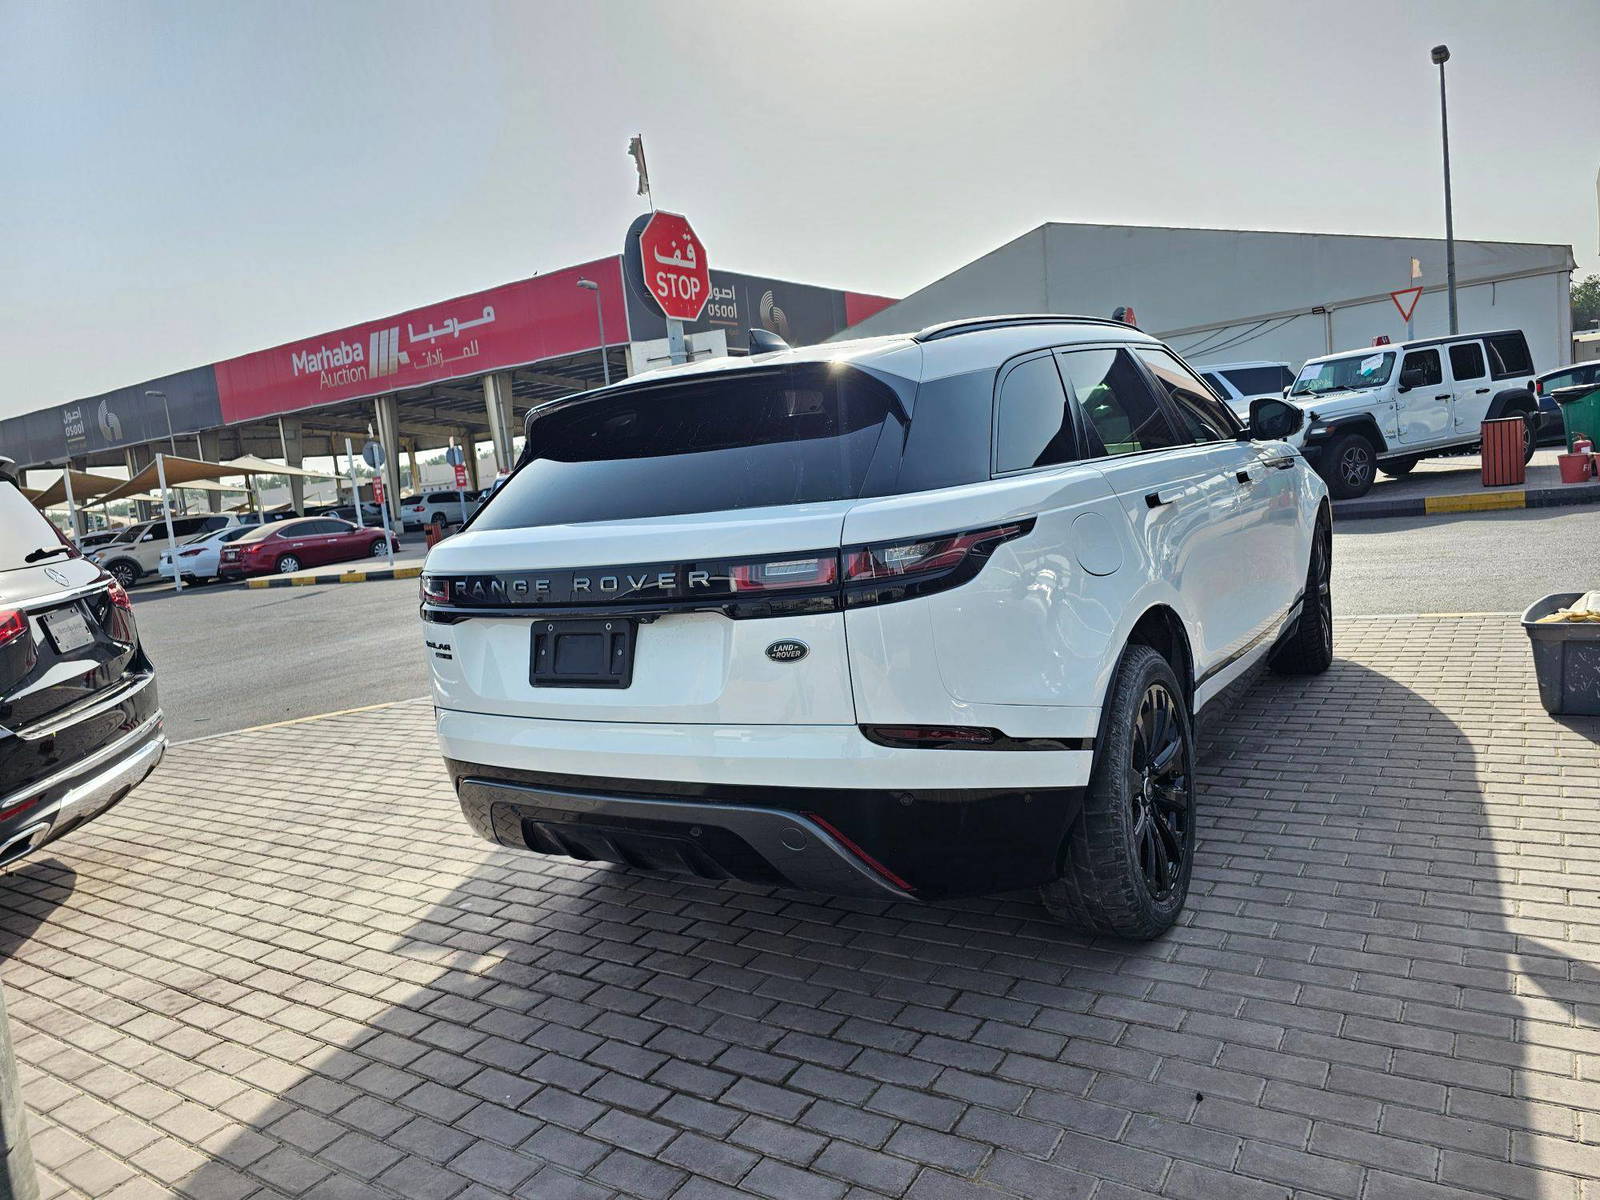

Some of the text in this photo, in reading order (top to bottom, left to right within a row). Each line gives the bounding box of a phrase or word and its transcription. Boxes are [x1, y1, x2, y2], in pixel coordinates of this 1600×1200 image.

[654, 233, 697, 269] قف
[656, 271, 700, 300] STOP
[408, 306, 496, 344] مرحبا
[291, 340, 364, 376] Marhaba
[319, 365, 367, 391] Auction
[454, 570, 711, 596] RANGE ROVER
[773, 644, 794, 652] LAND
[775, 650, 801, 659] ROVER
